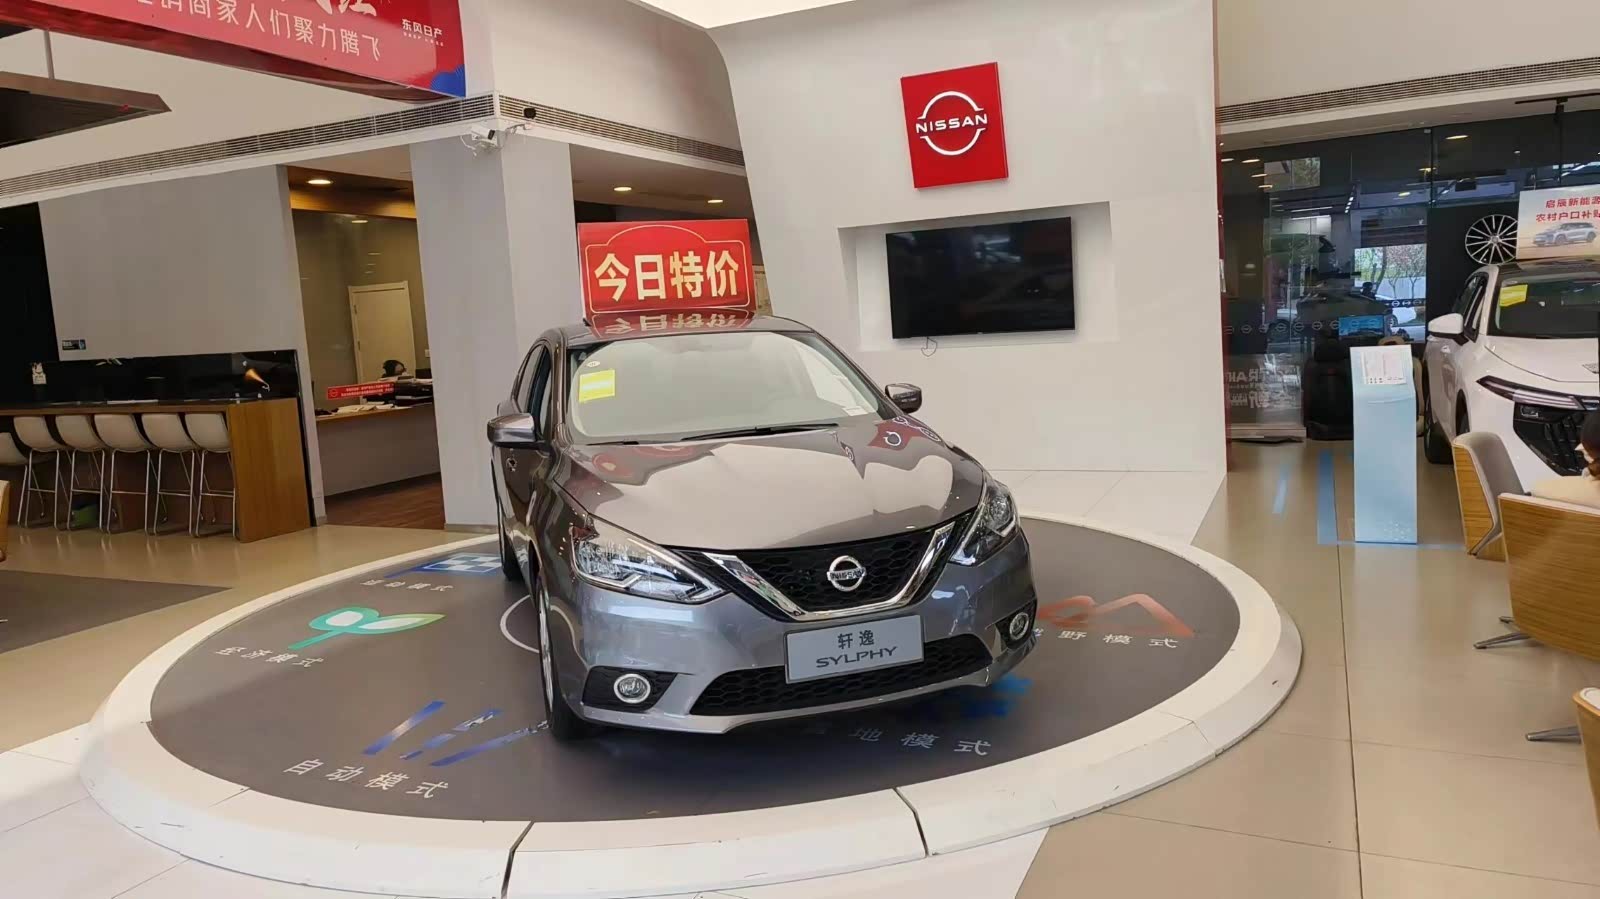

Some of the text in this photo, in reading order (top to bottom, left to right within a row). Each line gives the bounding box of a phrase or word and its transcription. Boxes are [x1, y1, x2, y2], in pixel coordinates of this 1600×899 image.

[138, 0, 381, 61] 商家人们聚力腾飞
[401, 18, 443, 38] 东风日产
[915, 113, 988, 134] NISSAN
[1545, 195, 1600, 209] 启辰新能源
[593, 249, 739, 302] 今日特价
[837, 629, 875, 650] 轩逸
[815, 645, 899, 669] SYLPHY
[802, 726, 992, 757] 地模式
[283, 758, 449, 799] 自动模式
